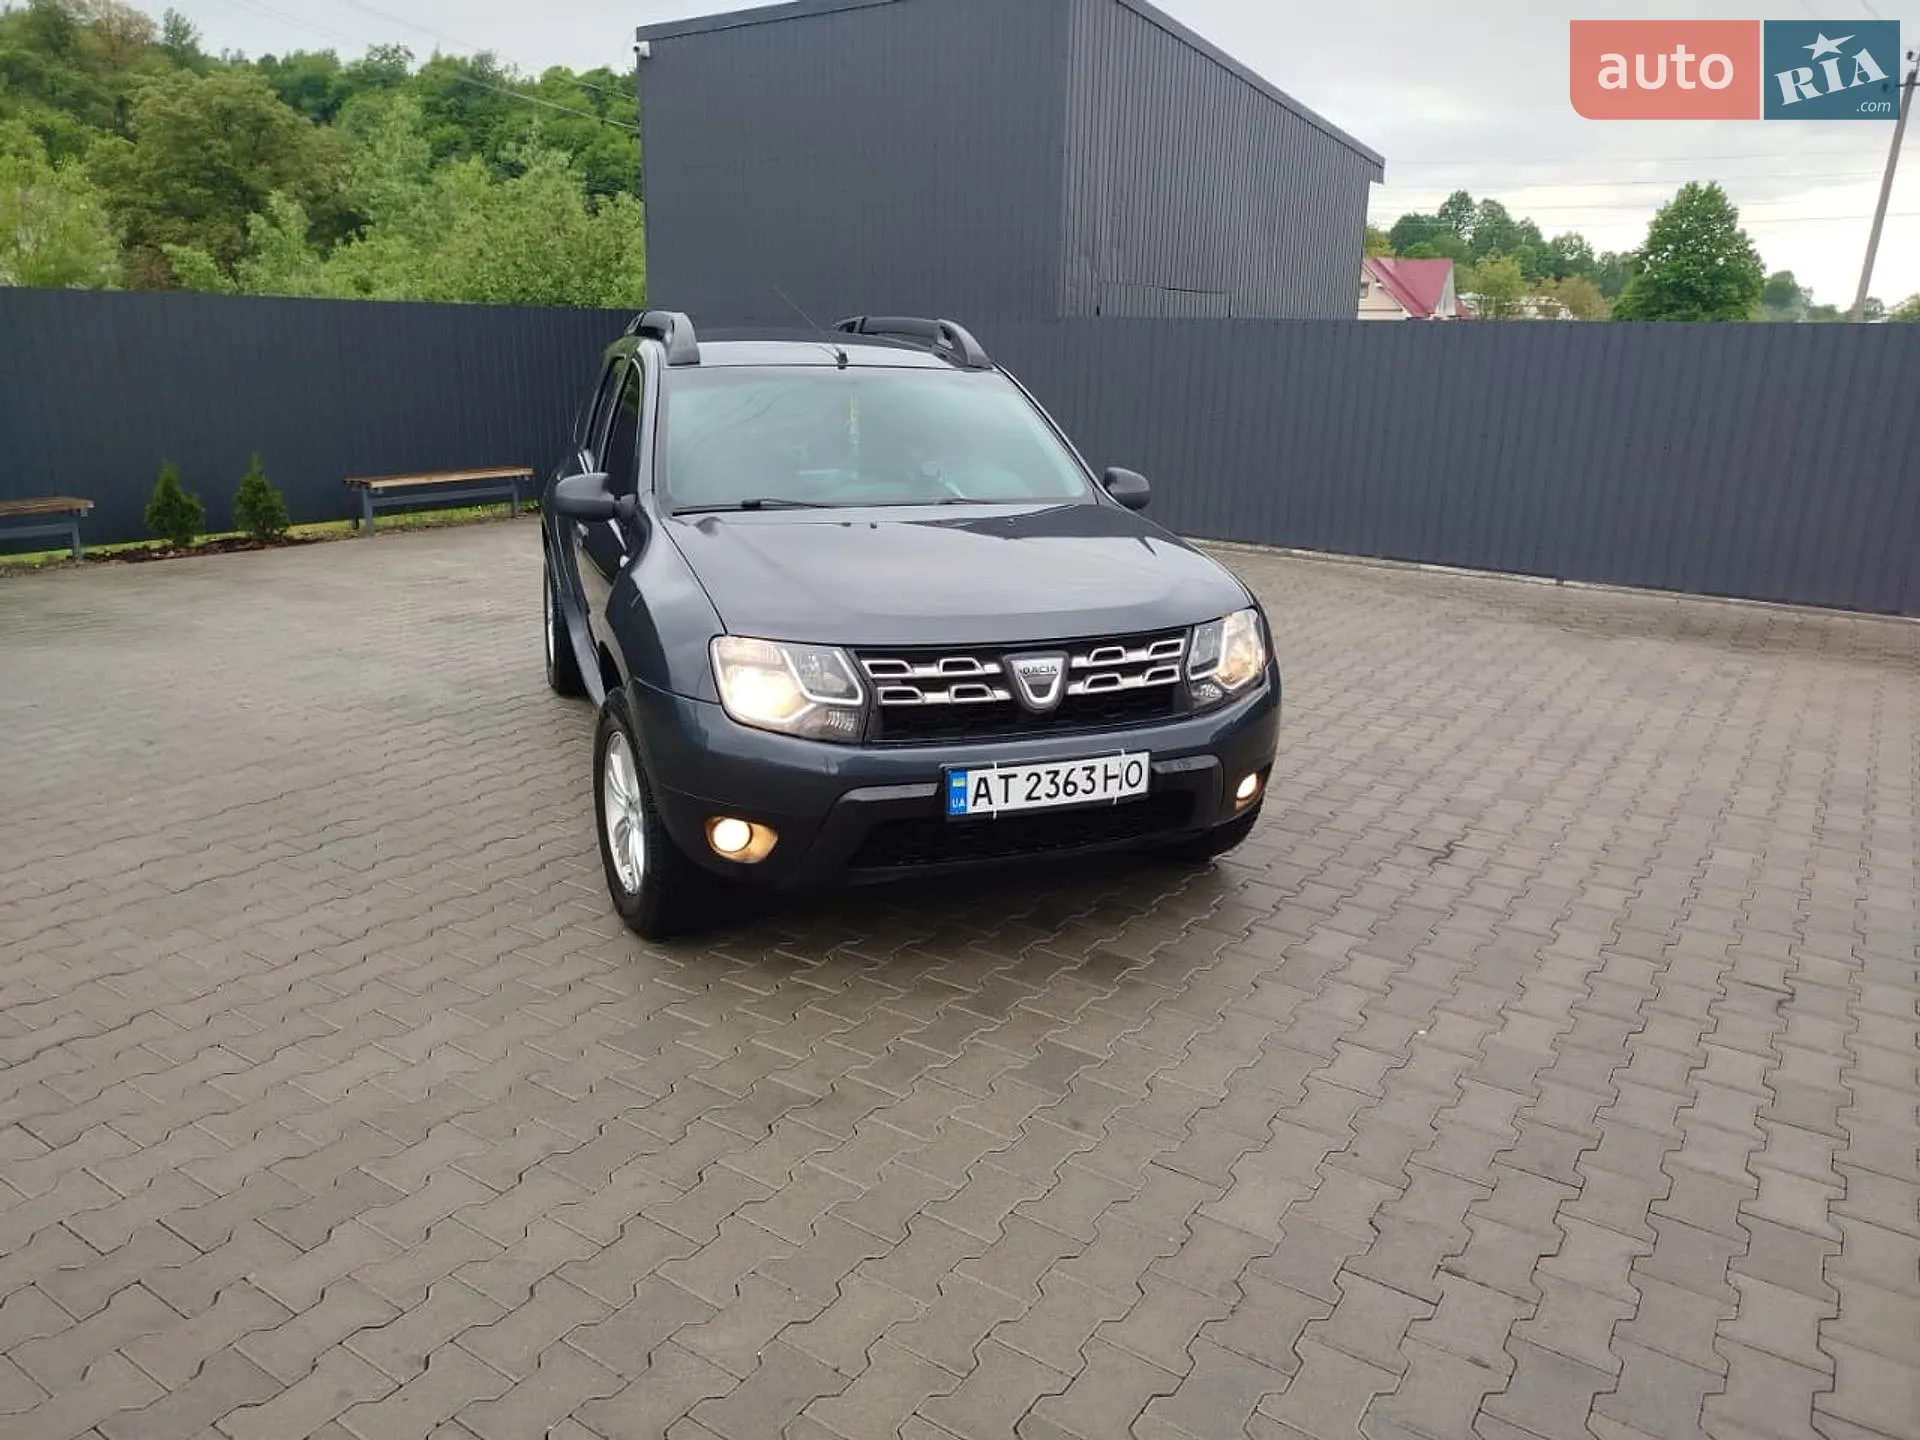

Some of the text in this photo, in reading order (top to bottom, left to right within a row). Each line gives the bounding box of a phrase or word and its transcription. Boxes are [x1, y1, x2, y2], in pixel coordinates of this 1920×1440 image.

[1019, 665, 1058, 675] DACIA
[972, 776, 1018, 807] AT
[1025, 766, 1096, 801] 2363
[952, 799, 965, 808] UA
